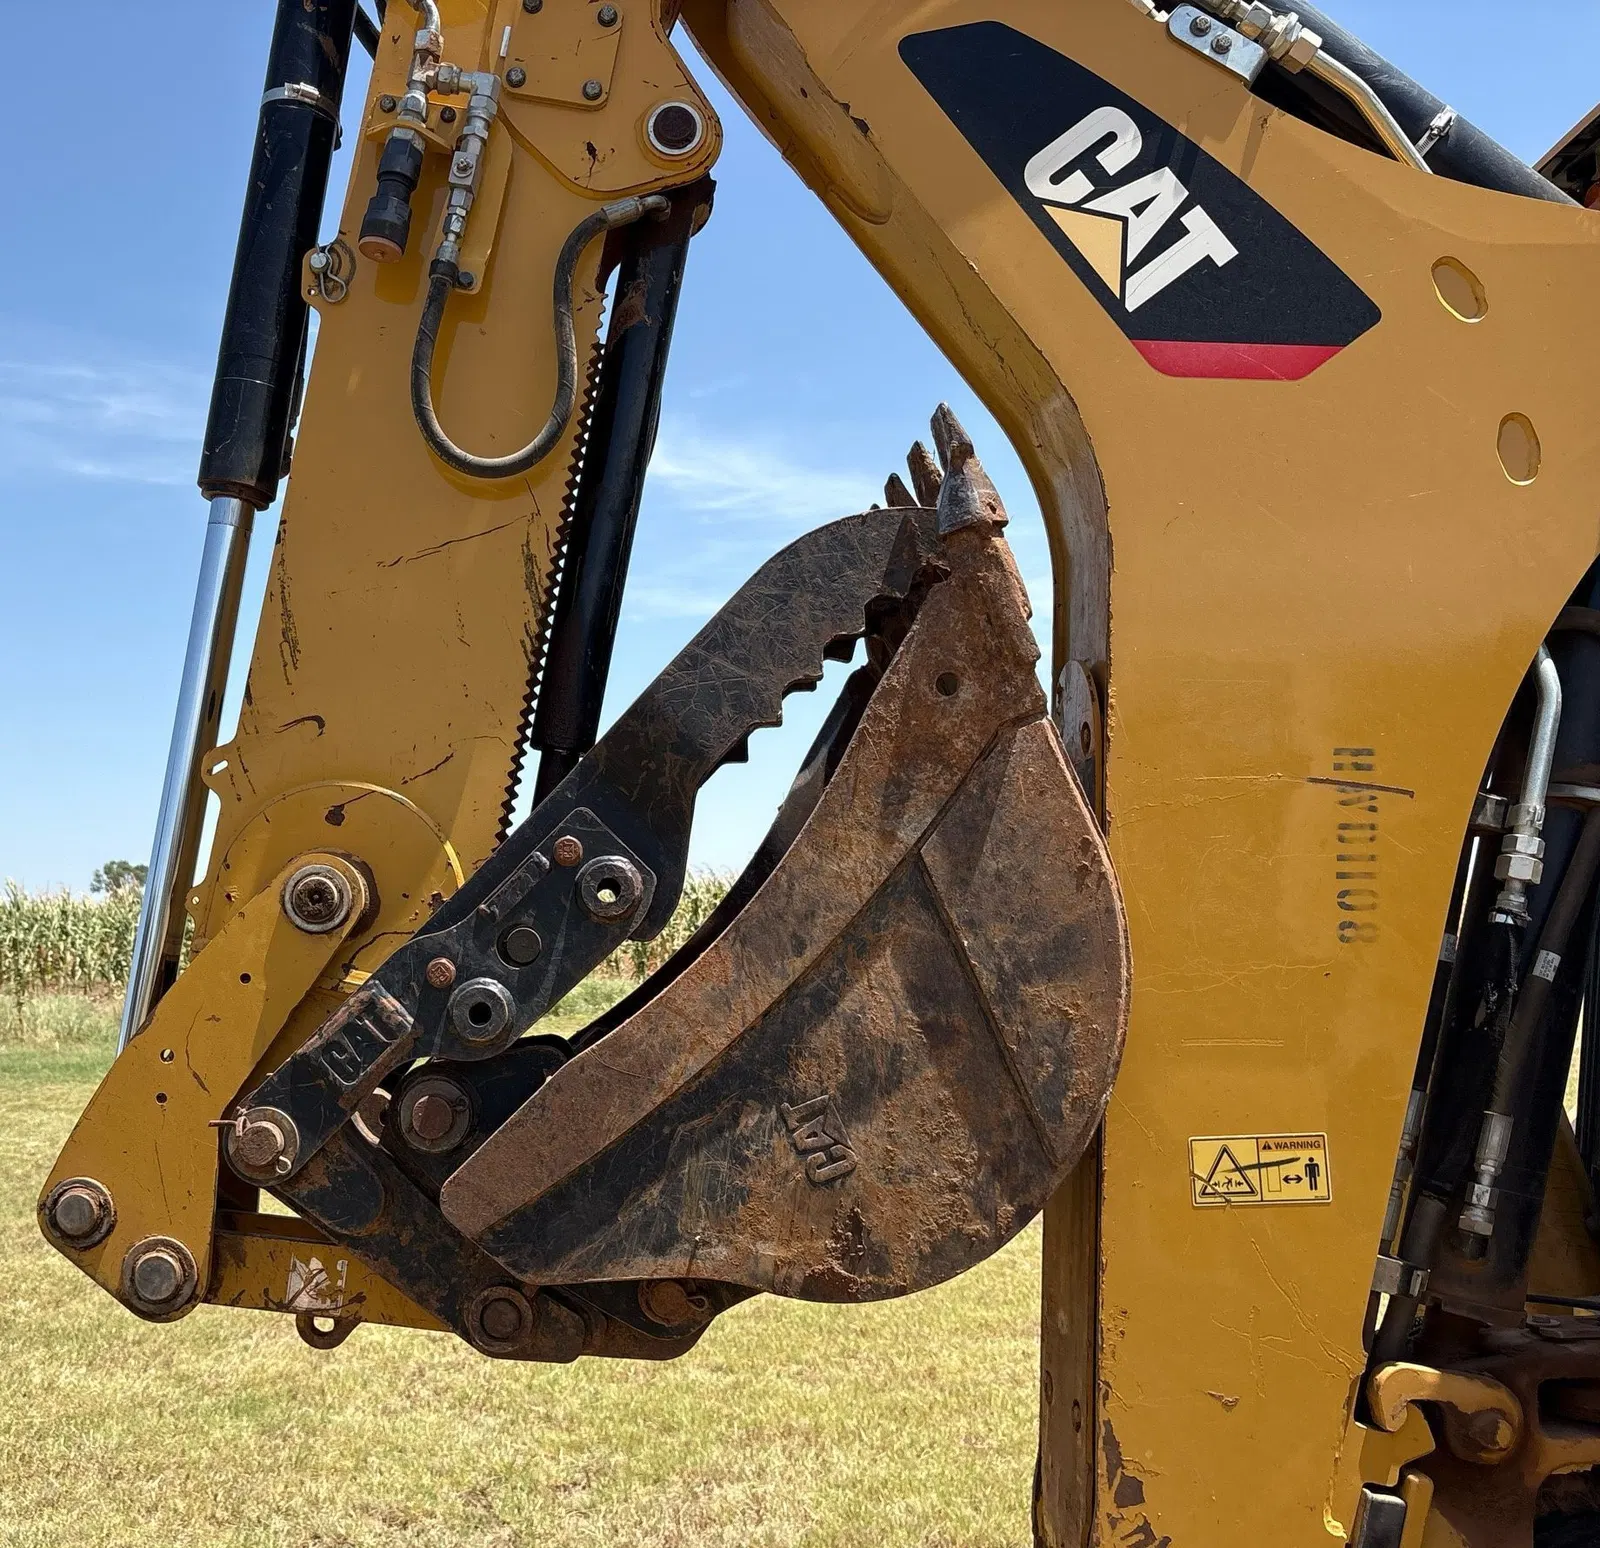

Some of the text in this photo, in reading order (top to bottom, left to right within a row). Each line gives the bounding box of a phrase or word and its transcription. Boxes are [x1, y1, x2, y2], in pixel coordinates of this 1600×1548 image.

[1024, 106, 1239, 313] CAT
[320, 1000, 399, 1085] CAT
[780, 1095, 858, 1186] CAT
[1274, 1140, 1321, 1150] WARNING
